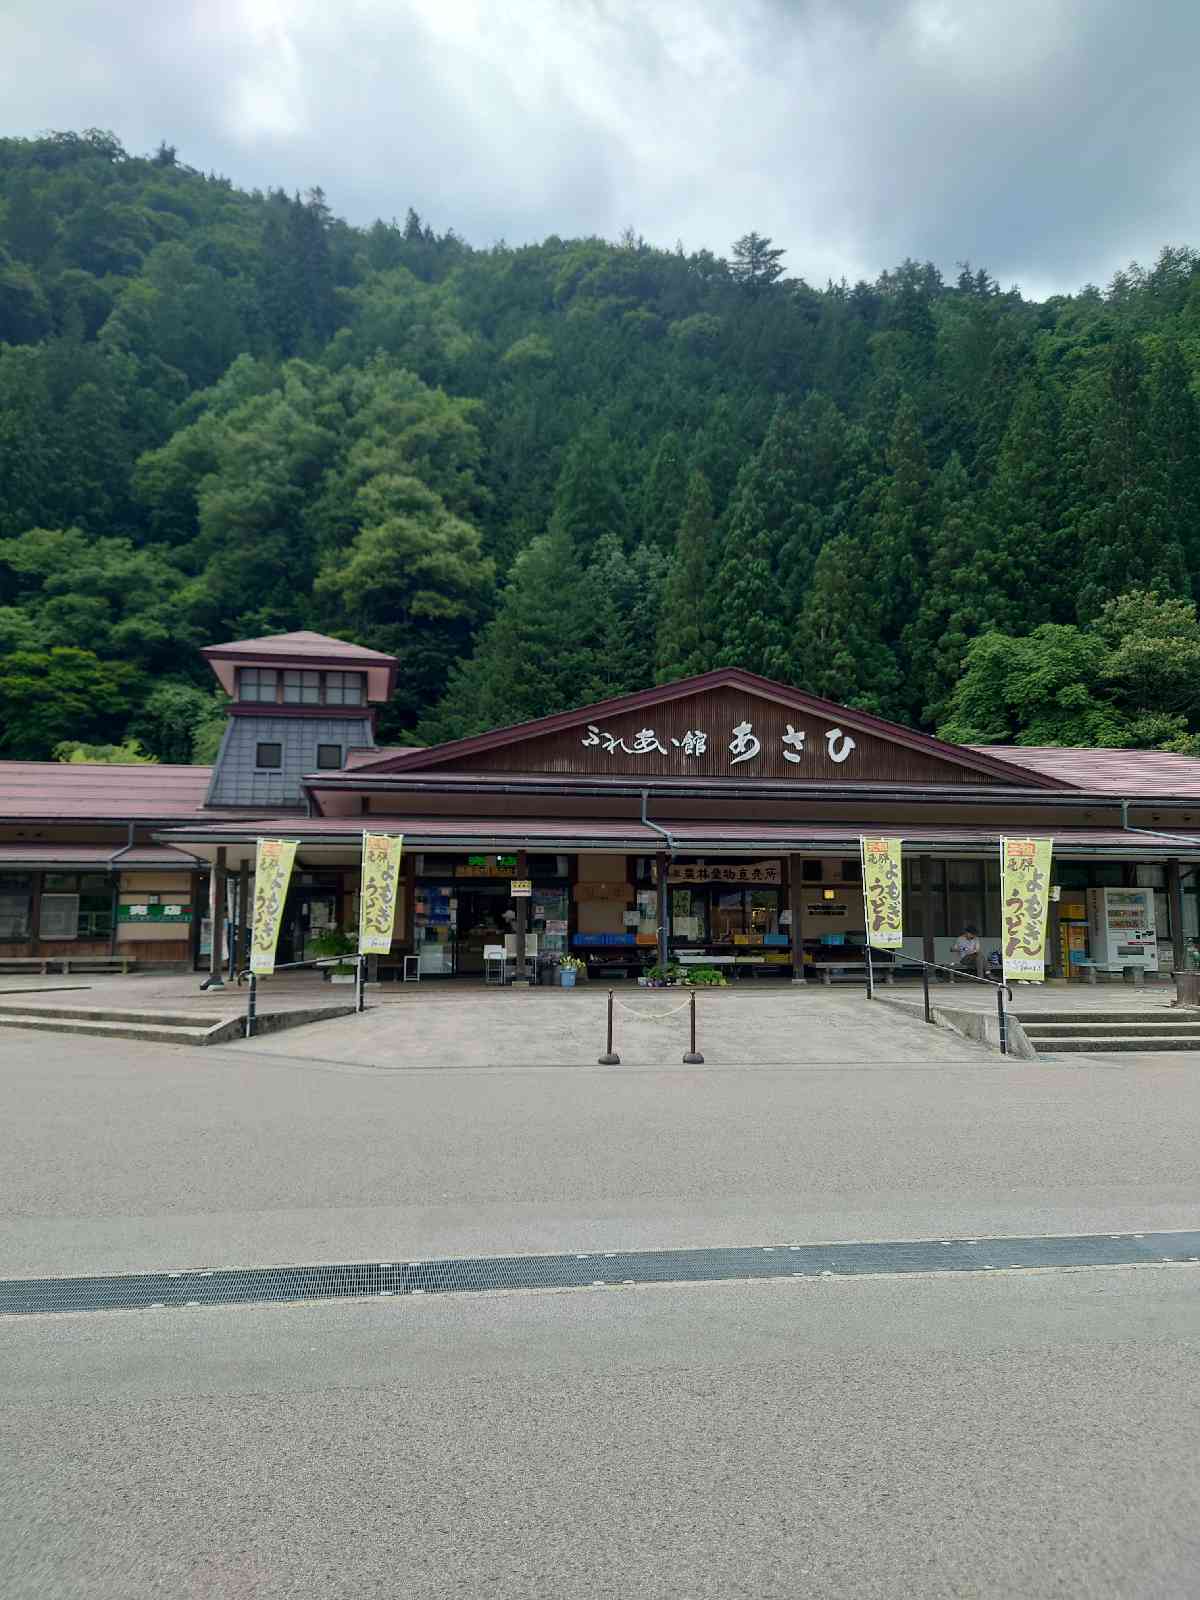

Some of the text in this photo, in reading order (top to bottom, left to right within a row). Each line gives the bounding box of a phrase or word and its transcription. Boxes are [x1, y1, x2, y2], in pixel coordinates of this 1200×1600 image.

[728, 720, 856, 765] あさひ
[1006, 888, 1042, 957] うどん
